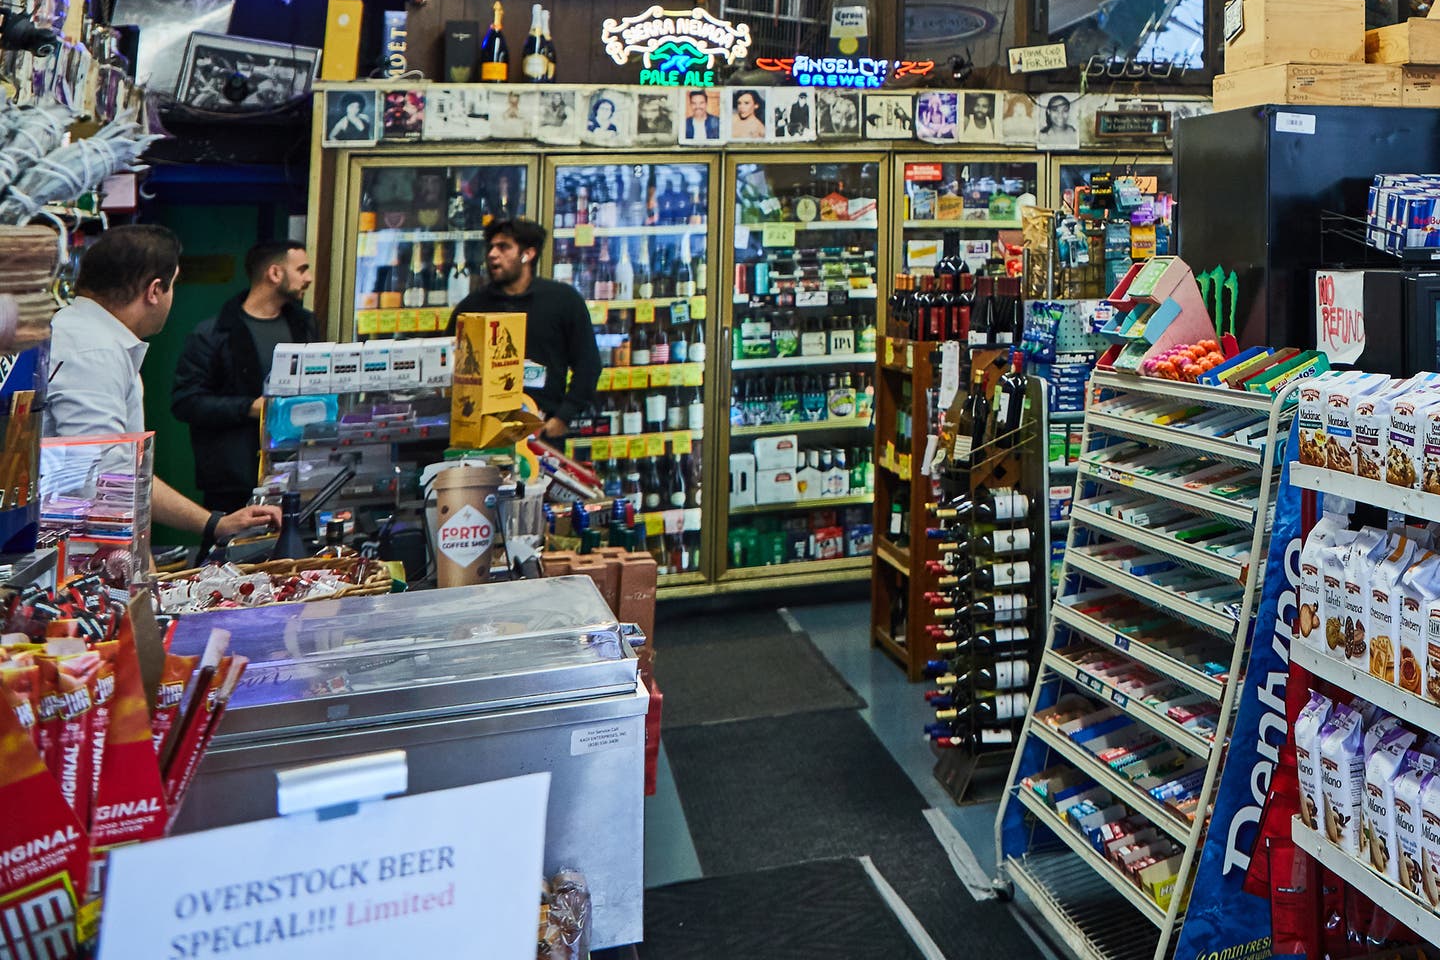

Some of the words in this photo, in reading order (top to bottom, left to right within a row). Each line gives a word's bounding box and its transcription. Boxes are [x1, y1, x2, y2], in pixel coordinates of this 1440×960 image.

[622, 18, 673, 44] SIERRA
[793, 56, 854, 77] ANGEL
[640, 69, 679, 87] PALE
[684, 69, 715, 87] ALE
[961, 165, 970, 182] 4
[1414, 216, 1430, 226] Red
[1317, 275, 1335, 306] NO
[1054, 352, 1088, 365] Gillette
[1300, 409, 1321, 421] Mackinac
[1327, 414, 1349, 428] Montauk
[1390, 416, 1417, 435] Nantucket
[442, 524, 491, 541] FORTO
[442, 540, 470, 550] COFFEE
[1325, 590, 1341, 608] Tahiti
[174, 860, 370, 921] OVERSTOCK
[378, 845, 455, 881] BEER
[168, 906, 336, 960] SPECIAL!!!
[346, 886, 455, 928] Limited
